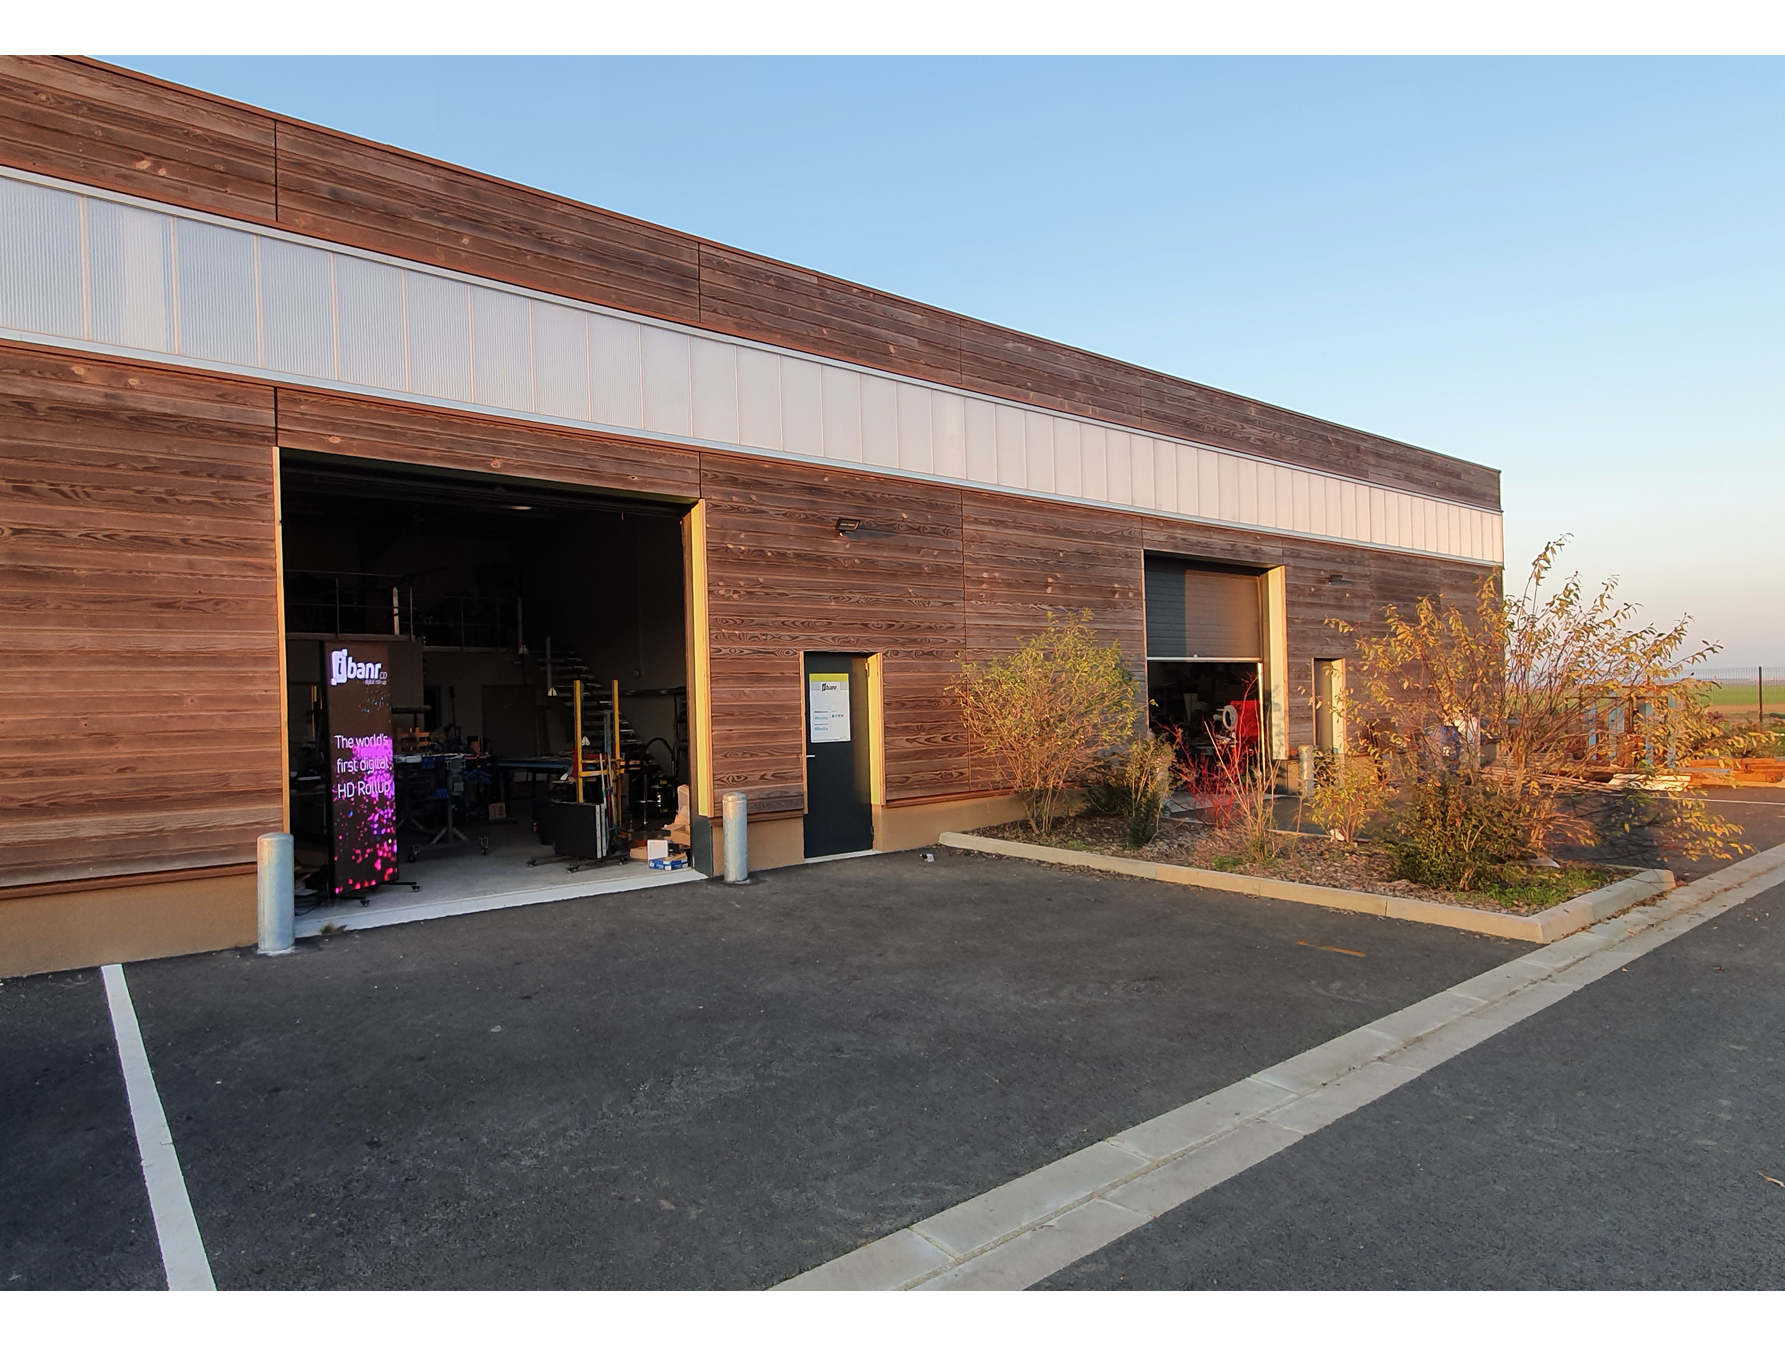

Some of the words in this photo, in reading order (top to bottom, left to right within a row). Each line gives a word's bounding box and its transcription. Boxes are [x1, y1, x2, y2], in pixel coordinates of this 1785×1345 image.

[334, 735, 354, 749] The
[356, 733, 389, 748] world's
[337, 758, 358, 773] first
[360, 757, 389, 773] digital
[338, 782, 355, 799] HD
[358, 780, 390, 797] Rollup
